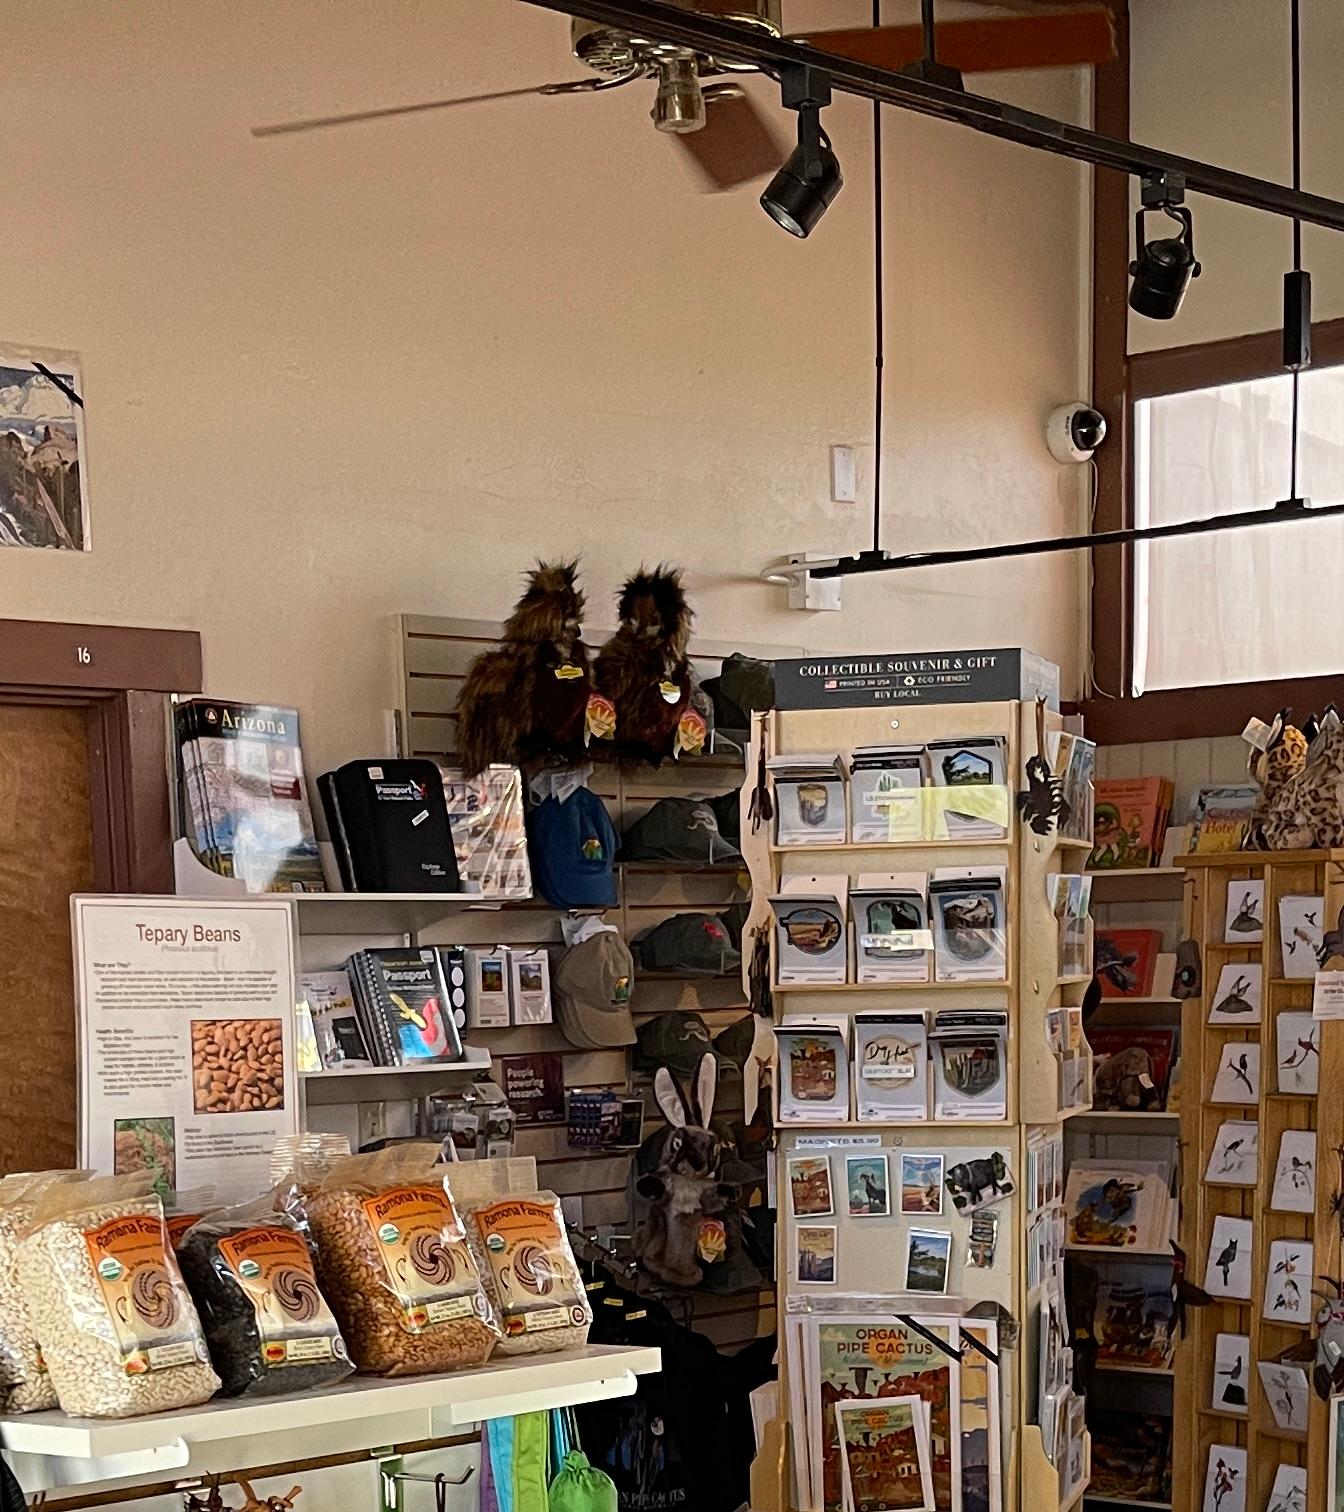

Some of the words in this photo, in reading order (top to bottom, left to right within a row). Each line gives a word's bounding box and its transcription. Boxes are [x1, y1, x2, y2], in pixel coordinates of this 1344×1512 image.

[77, 647, 91, 664] 16
[799, 662, 884, 677] COLLECTIBLE
[887, 658, 950, 673] SOUVENIR
[953, 657, 963, 669] &
[967, 656, 997, 668] GIFT
[839, 679, 866, 687] PRINTED
[877, 678, 890, 686] USA
[918, 676, 934, 684] ECO
[936, 674, 971, 683] FRIENDLY
[874, 690, 891, 699] BUY
[893, 689, 920, 698] LOCAL
[222, 708, 286, 735] Arizona
[1206, 822, 1237, 834] Hotel
[136, 923, 188, 946] Tepary
[194, 924, 241, 942] Beans
[383, 968, 432, 983] Passport
[507, 1067, 534, 1078] People
[508, 1078, 544, 1090] powering
[375, 1191, 413, 1217] Ramona
[484, 1206, 521, 1228] Ramona
[96, 1222, 137, 1250] Ramona
[232, 1231, 268, 1254] Ramona
[856, 1328, 908, 1340] ORGAN
[837, 1342, 869, 1354] PIPE
[875, 1342, 933, 1355] CACTUS
